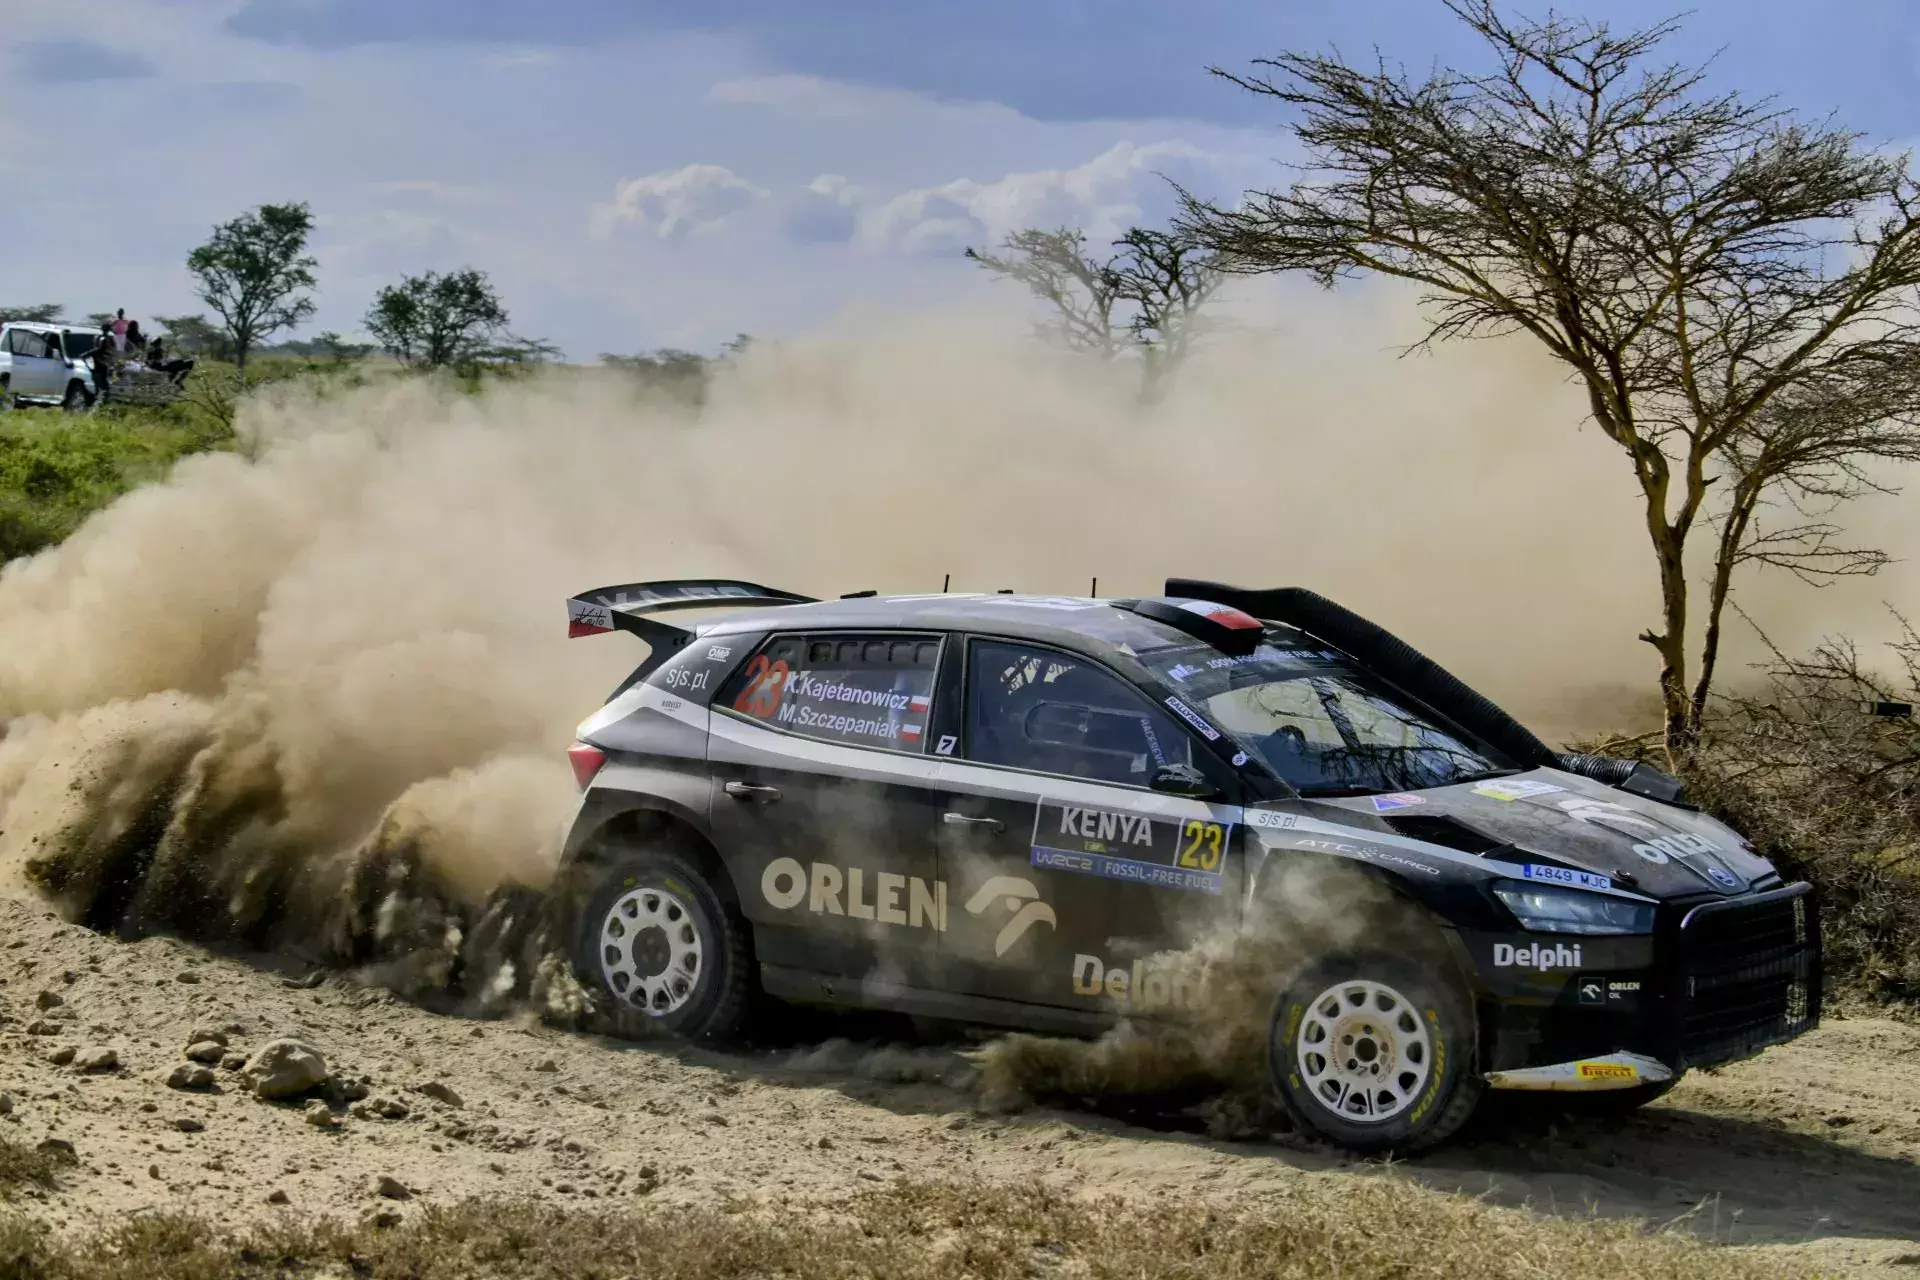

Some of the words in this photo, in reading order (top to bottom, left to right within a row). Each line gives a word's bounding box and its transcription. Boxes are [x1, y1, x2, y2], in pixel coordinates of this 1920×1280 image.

[707, 647, 730, 660] OMP
[666, 665, 710, 691] sjs.pl
[734, 654, 788, 718] 23
[784, 672, 910, 711] K.Kajetanowicz
[778, 703, 901, 740] M.Szczepaniak
[941, 738, 953, 750] 7
[1060, 806, 1153, 846] KENYA
[1258, 811, 1298, 829] sjspl
[1179, 820, 1222, 870] 23
[1296, 839, 1354, 852] ATC
[1379, 852, 1441, 876] CARGO
[1632, 831, 1725, 865] ORLEN
[1036, 851, 1094, 871] WRC2
[1105, 861, 1183, 886] FOSSIL-FREE
[1184, 874, 1216, 891] FUEL
[1535, 866, 1573, 883] 4849
[1581, 873, 1608, 890] MJC
[760, 856, 947, 932] ORLEN
[1493, 942, 1582, 972] Delphi
[1609, 982, 1640, 991] ORLEN
[1581, 1065, 1632, 1078] PIRELLI
